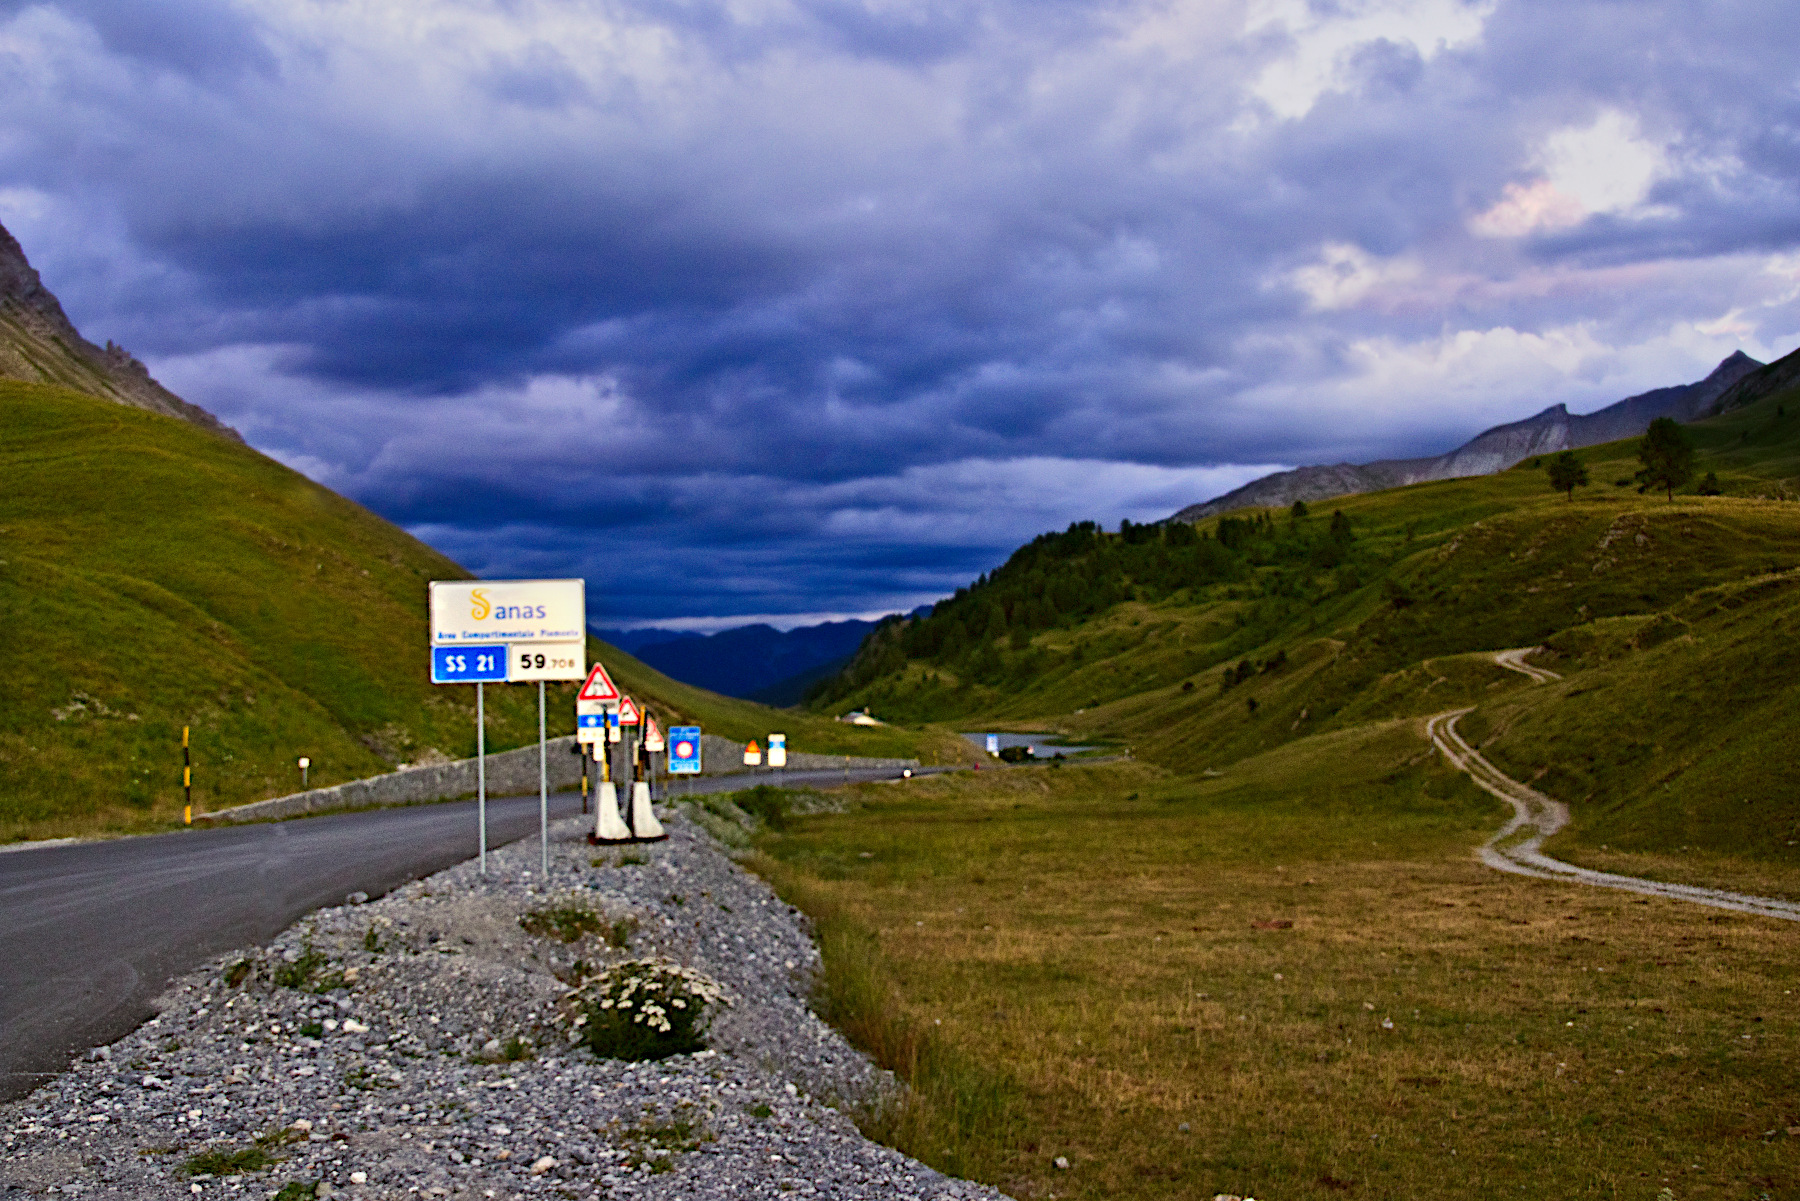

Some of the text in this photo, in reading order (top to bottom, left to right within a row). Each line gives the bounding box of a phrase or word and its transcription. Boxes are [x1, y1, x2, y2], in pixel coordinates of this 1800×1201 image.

[494, 604, 546, 620] anas
[445, 655, 494, 672] SS 21
